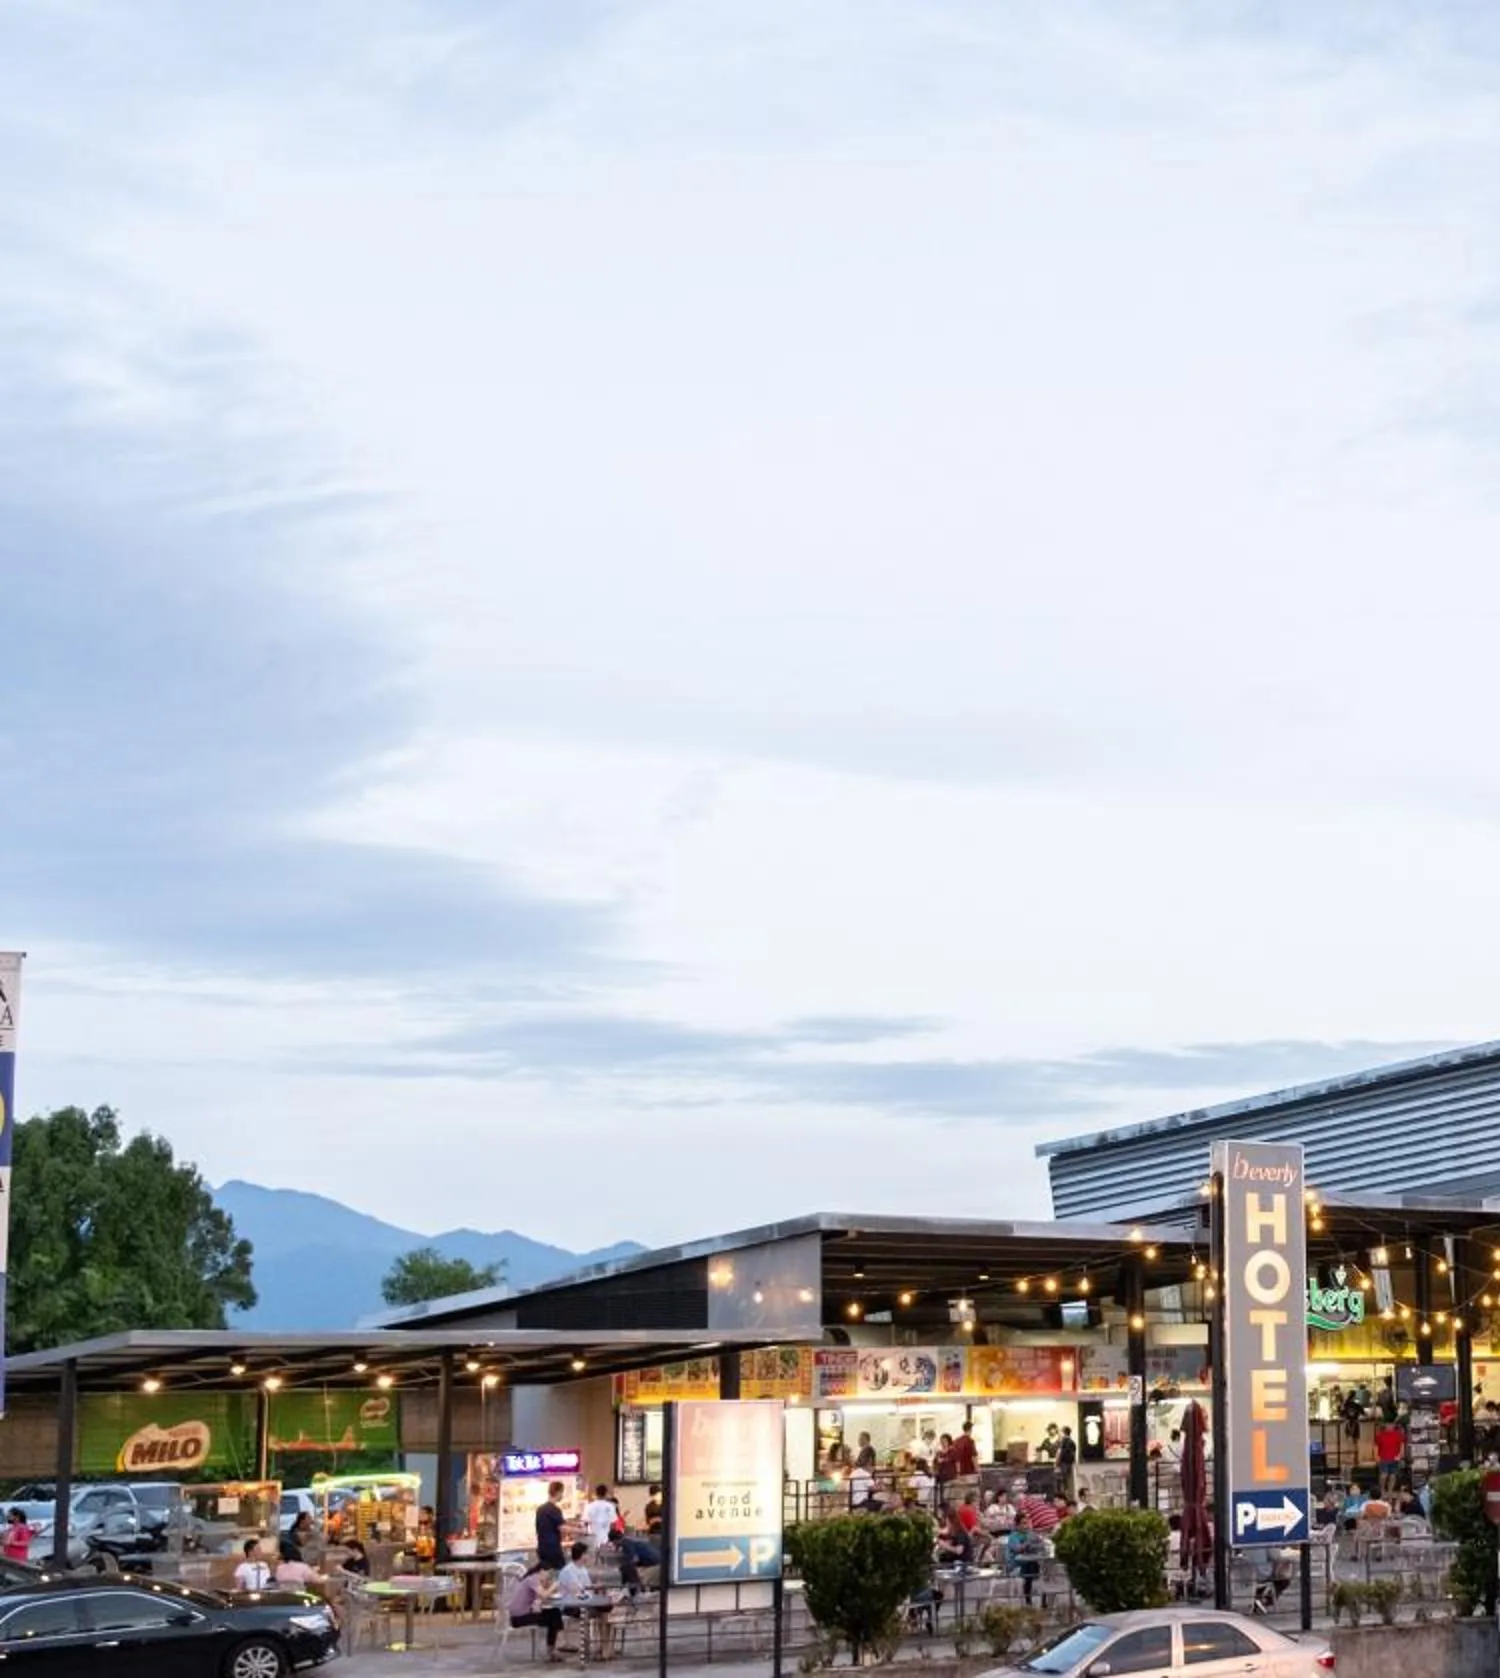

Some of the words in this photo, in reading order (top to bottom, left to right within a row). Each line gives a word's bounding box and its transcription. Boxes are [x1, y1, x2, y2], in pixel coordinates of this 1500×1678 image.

[1233, 1152, 1298, 1187] beverly
[1244, 1192, 1290, 1482] HOTEL
[131, 1437, 204, 1466] MILO
[695, 1505, 763, 1520] avenue
[708, 1490, 751, 1507] food
[1236, 1502, 1257, 1536] P
[750, 1537, 776, 1574] P
